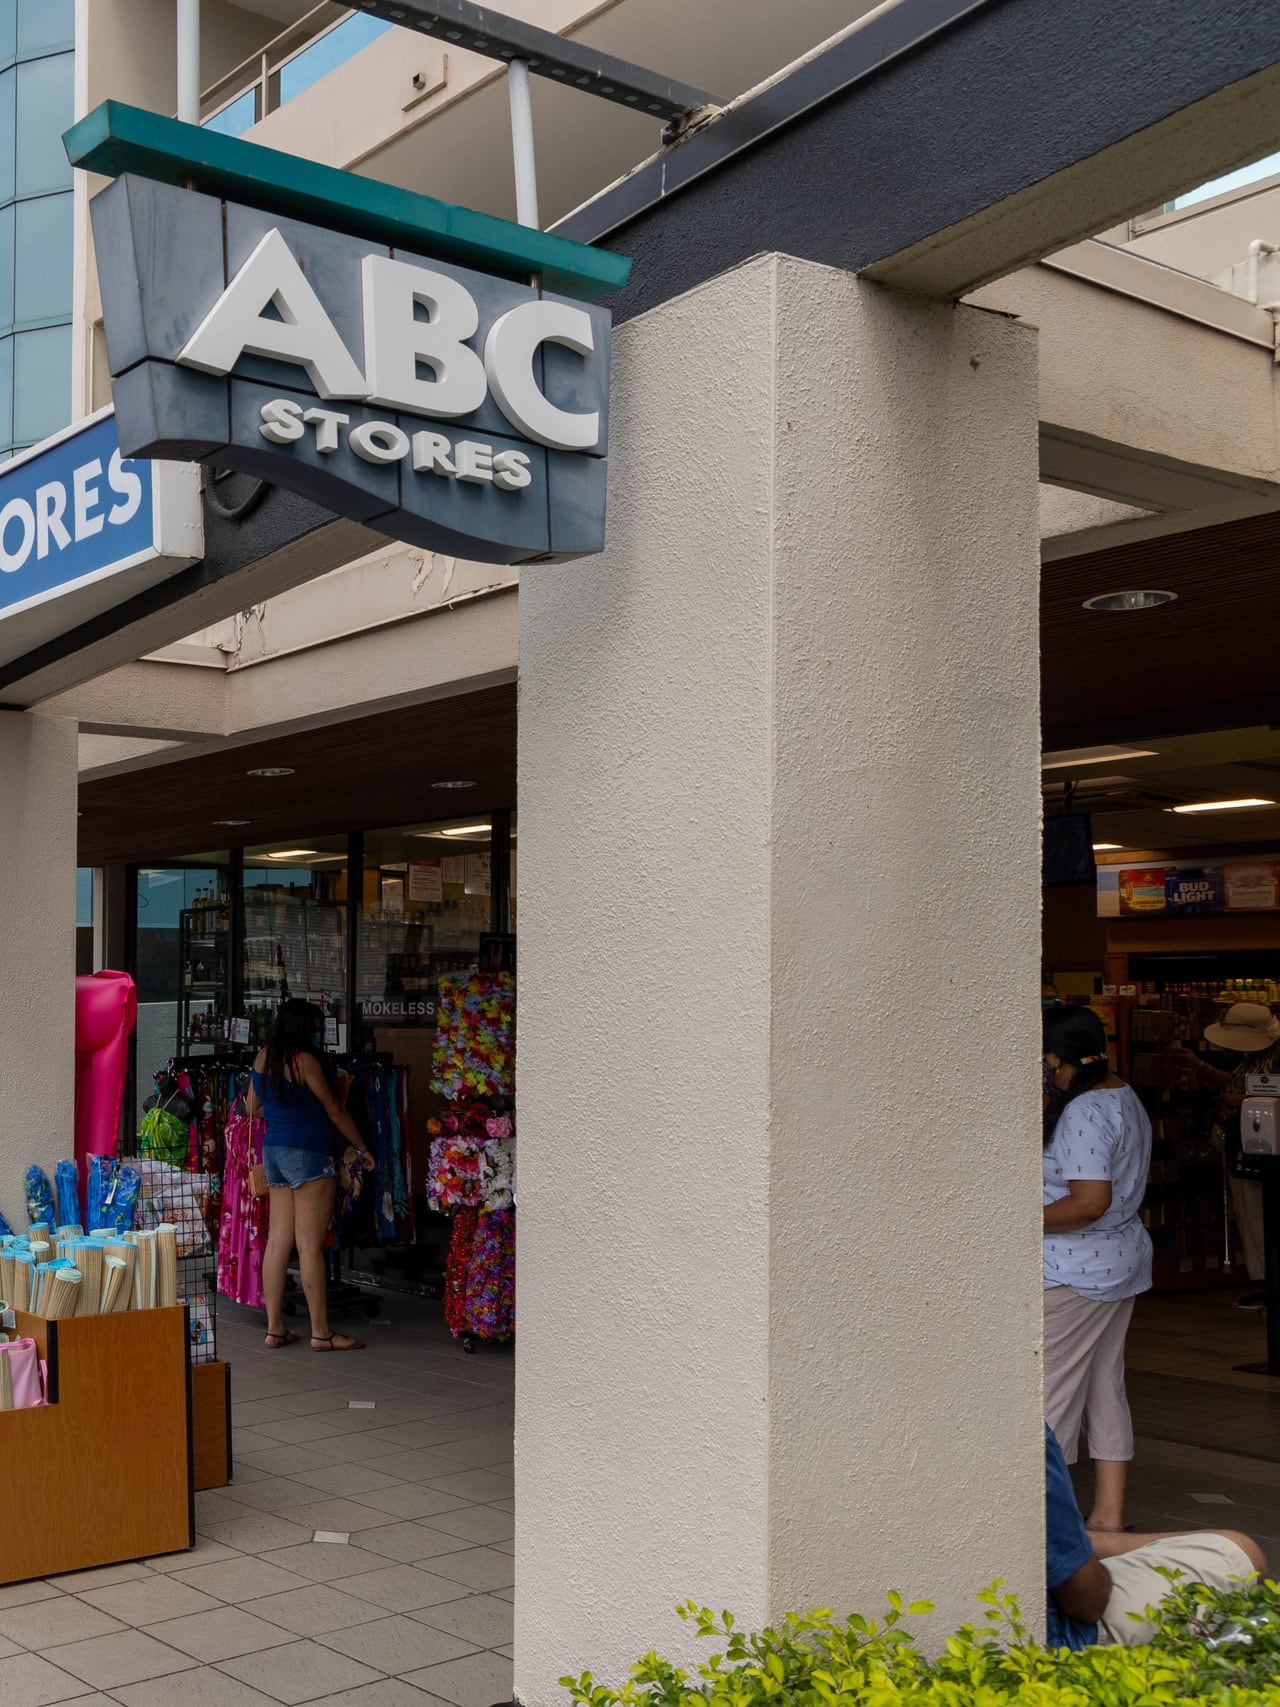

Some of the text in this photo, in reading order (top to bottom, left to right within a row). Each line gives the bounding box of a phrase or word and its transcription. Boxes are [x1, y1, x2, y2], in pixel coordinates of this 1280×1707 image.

[175, 227, 599, 451] ABC
[259, 399, 532, 491] STORES
[1179, 882, 1209, 892] BUD
[1173, 890, 1215, 903] LIGHT
[362, 1002, 435, 1015] MOKELESS
